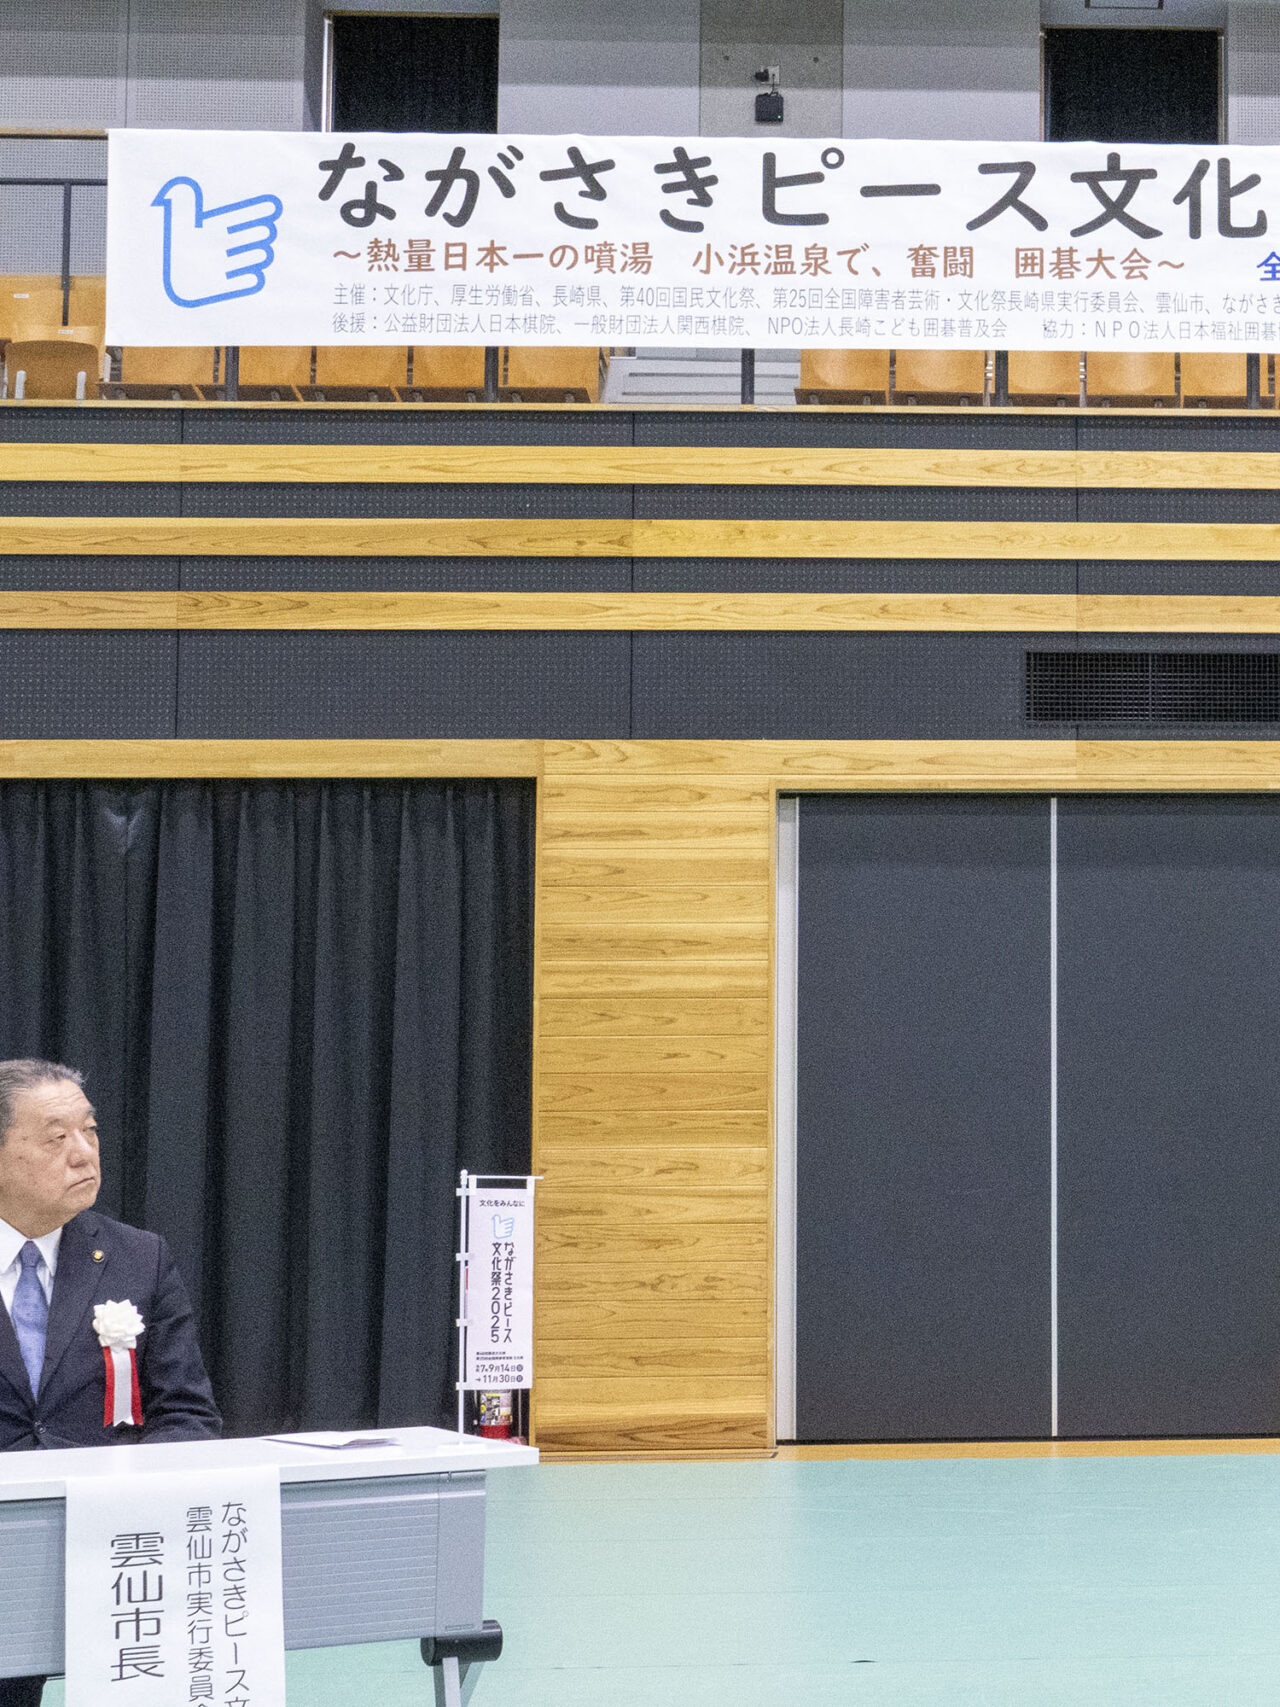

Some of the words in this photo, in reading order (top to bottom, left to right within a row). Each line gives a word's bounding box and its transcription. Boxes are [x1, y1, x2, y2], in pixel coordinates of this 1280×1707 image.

[491, 1242, 502, 1343] 文化祭2025
[504, 1242, 517, 1343] ながさきピース
[110, 1531, 165, 1682] 雲仙市長
[186, 1506, 214, 1707] 雲仙市実行委員
